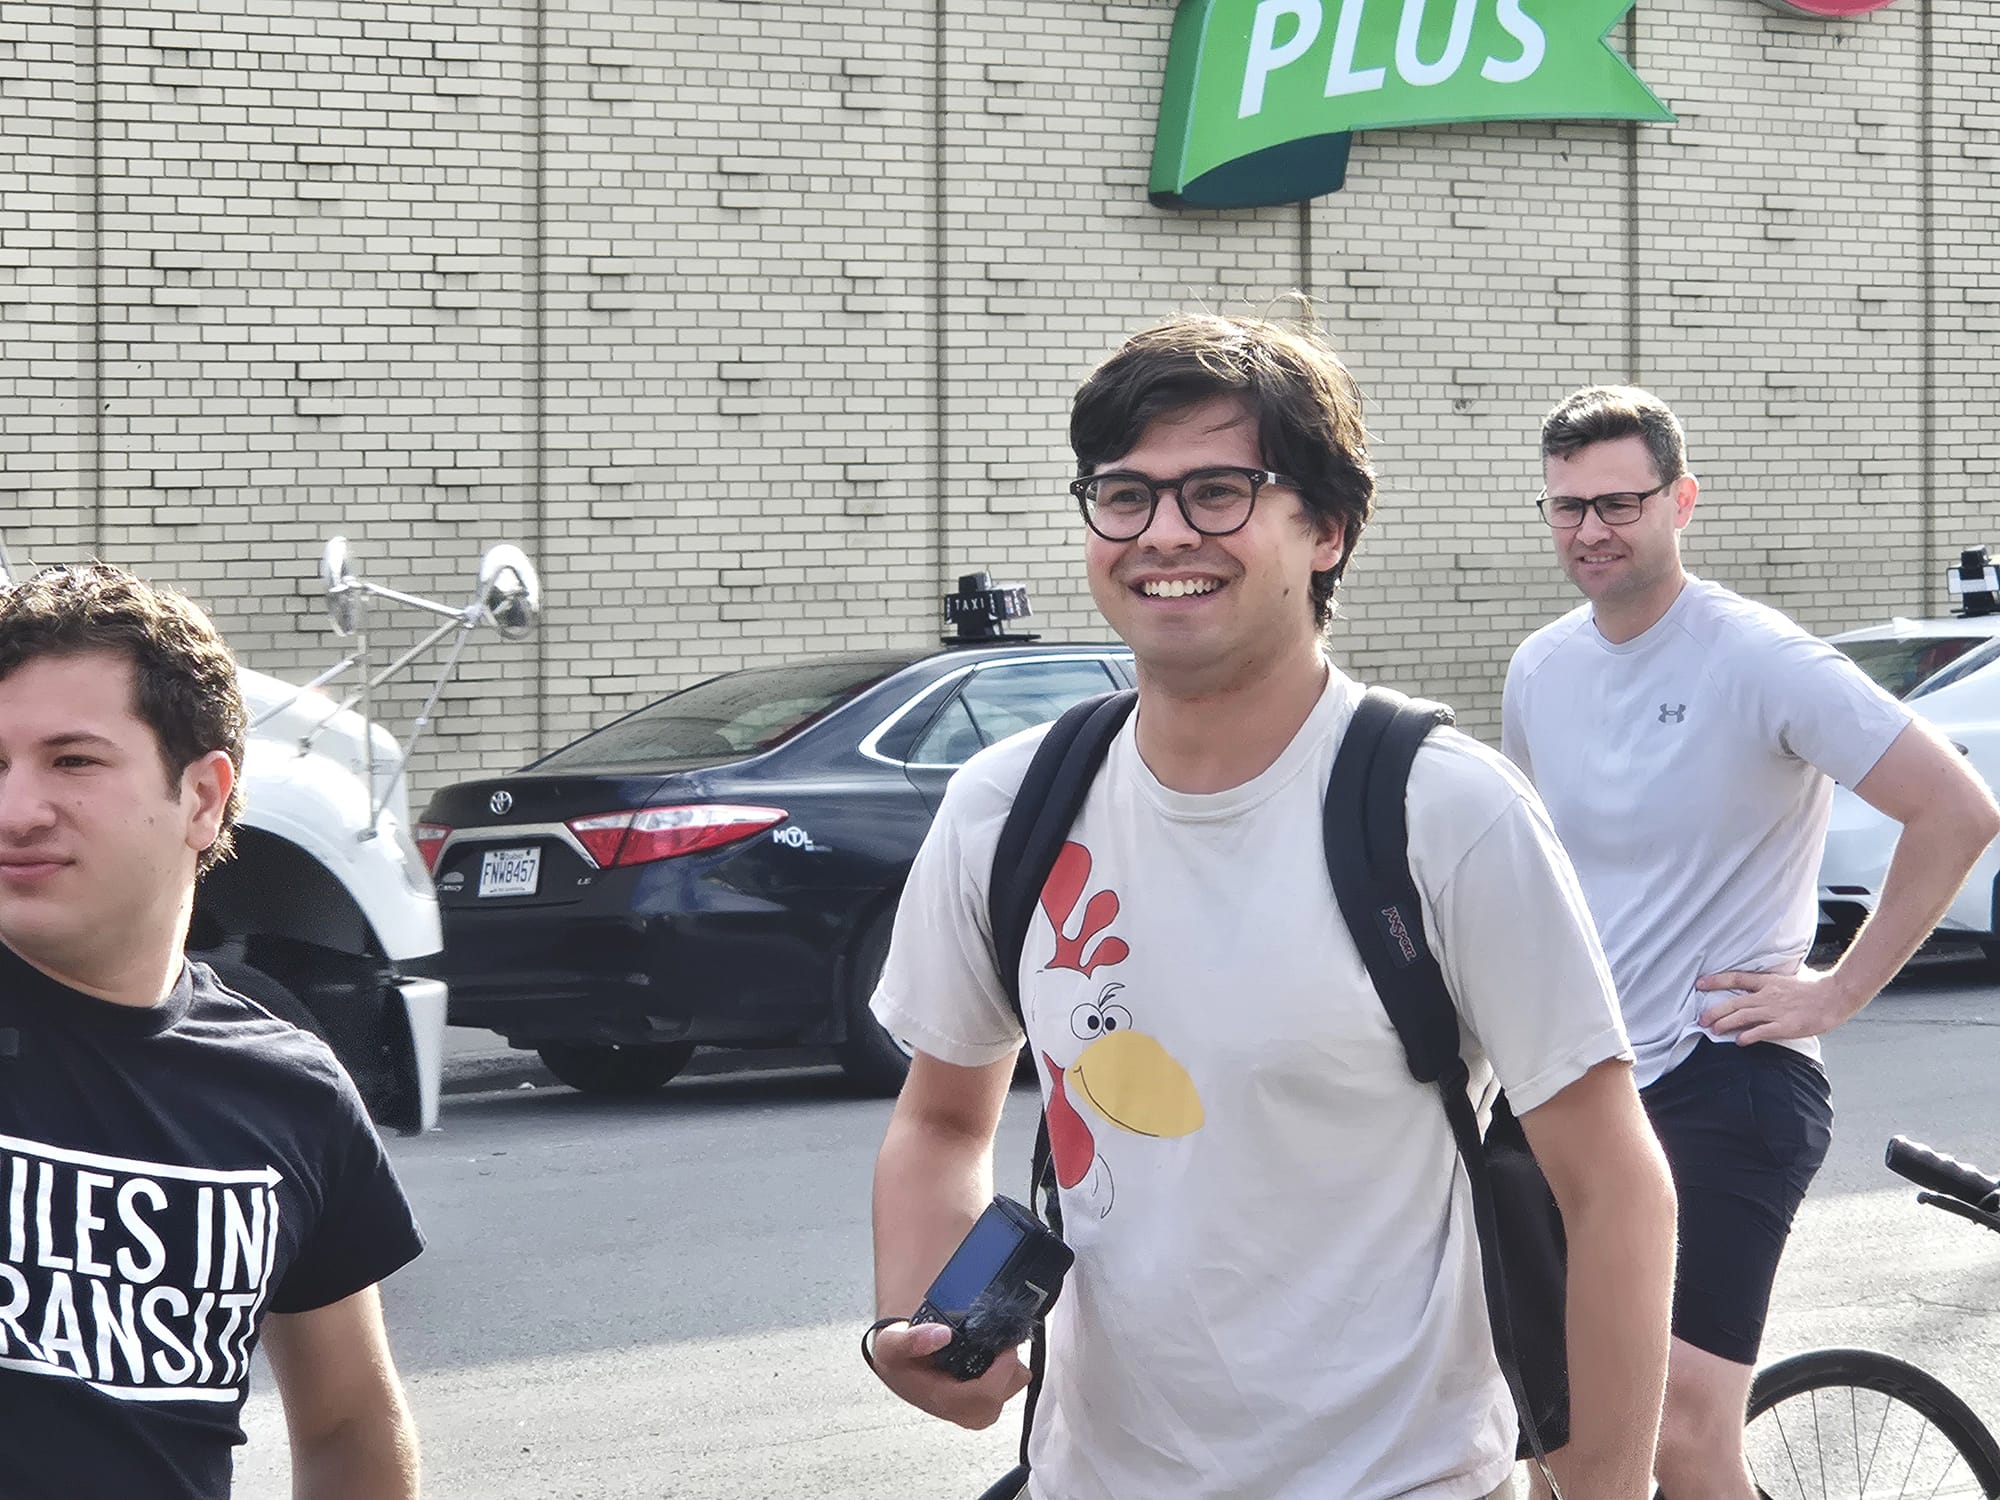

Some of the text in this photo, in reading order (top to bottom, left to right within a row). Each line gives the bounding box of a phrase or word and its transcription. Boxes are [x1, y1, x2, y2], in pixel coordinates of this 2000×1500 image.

[1237, 0, 1547, 120] PLUS
[955, 597, 985, 611] TAXI
[773, 826, 813, 848] MTL
[483, 859, 536, 886] FNW8457
[194, 1186, 266, 1291] IN
